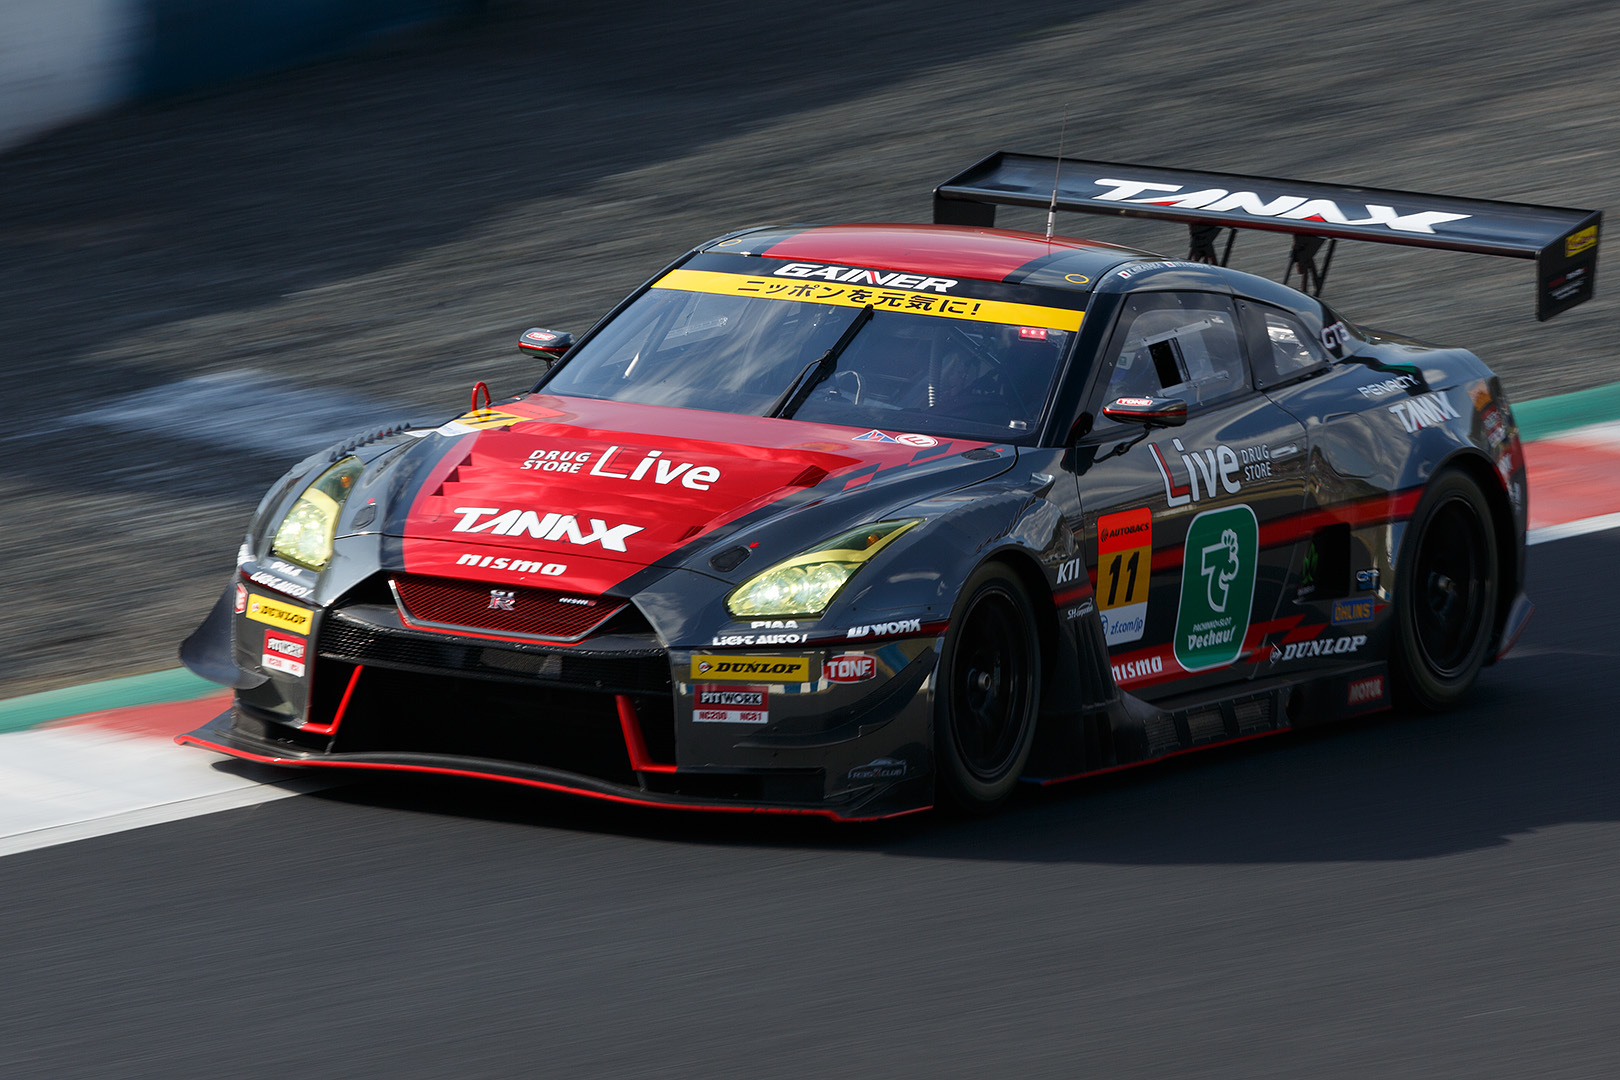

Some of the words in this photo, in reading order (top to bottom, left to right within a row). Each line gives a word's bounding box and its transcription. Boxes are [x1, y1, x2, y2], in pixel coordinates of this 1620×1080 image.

[1093, 178, 1473, 234] TANAX
[773, 262, 960, 293] GAINER
[1321, 321, 1351, 349] GT3
[1357, 374, 1420, 399] PENALTY
[1387, 390, 1462, 434] TANAX
[528, 449, 592, 463] DRUG
[1239, 444, 1270, 464] DRUG
[519, 459, 585, 475] STORE
[588, 445, 721, 492] Live
[1148, 437, 1240, 508] Live
[1243, 461, 1273, 482] STORE
[451, 506, 646, 553] TANAX
[1109, 522, 1149, 538] AUTOBACS
[1056, 557, 1081, 585] KTI
[1107, 551, 1140, 606] 11
[750, 620, 799, 629] PIAA
[870, 618, 922, 636] WORK
[1110, 616, 1144, 636] zf.com/jp
[1281, 634, 1368, 662] DUNLOP
[716, 661, 802, 674] DUNLOP
[826, 659, 873, 679] TONE
[700, 692, 762, 706] PITWORK
[1349, 678, 1382, 703] MOTUL
